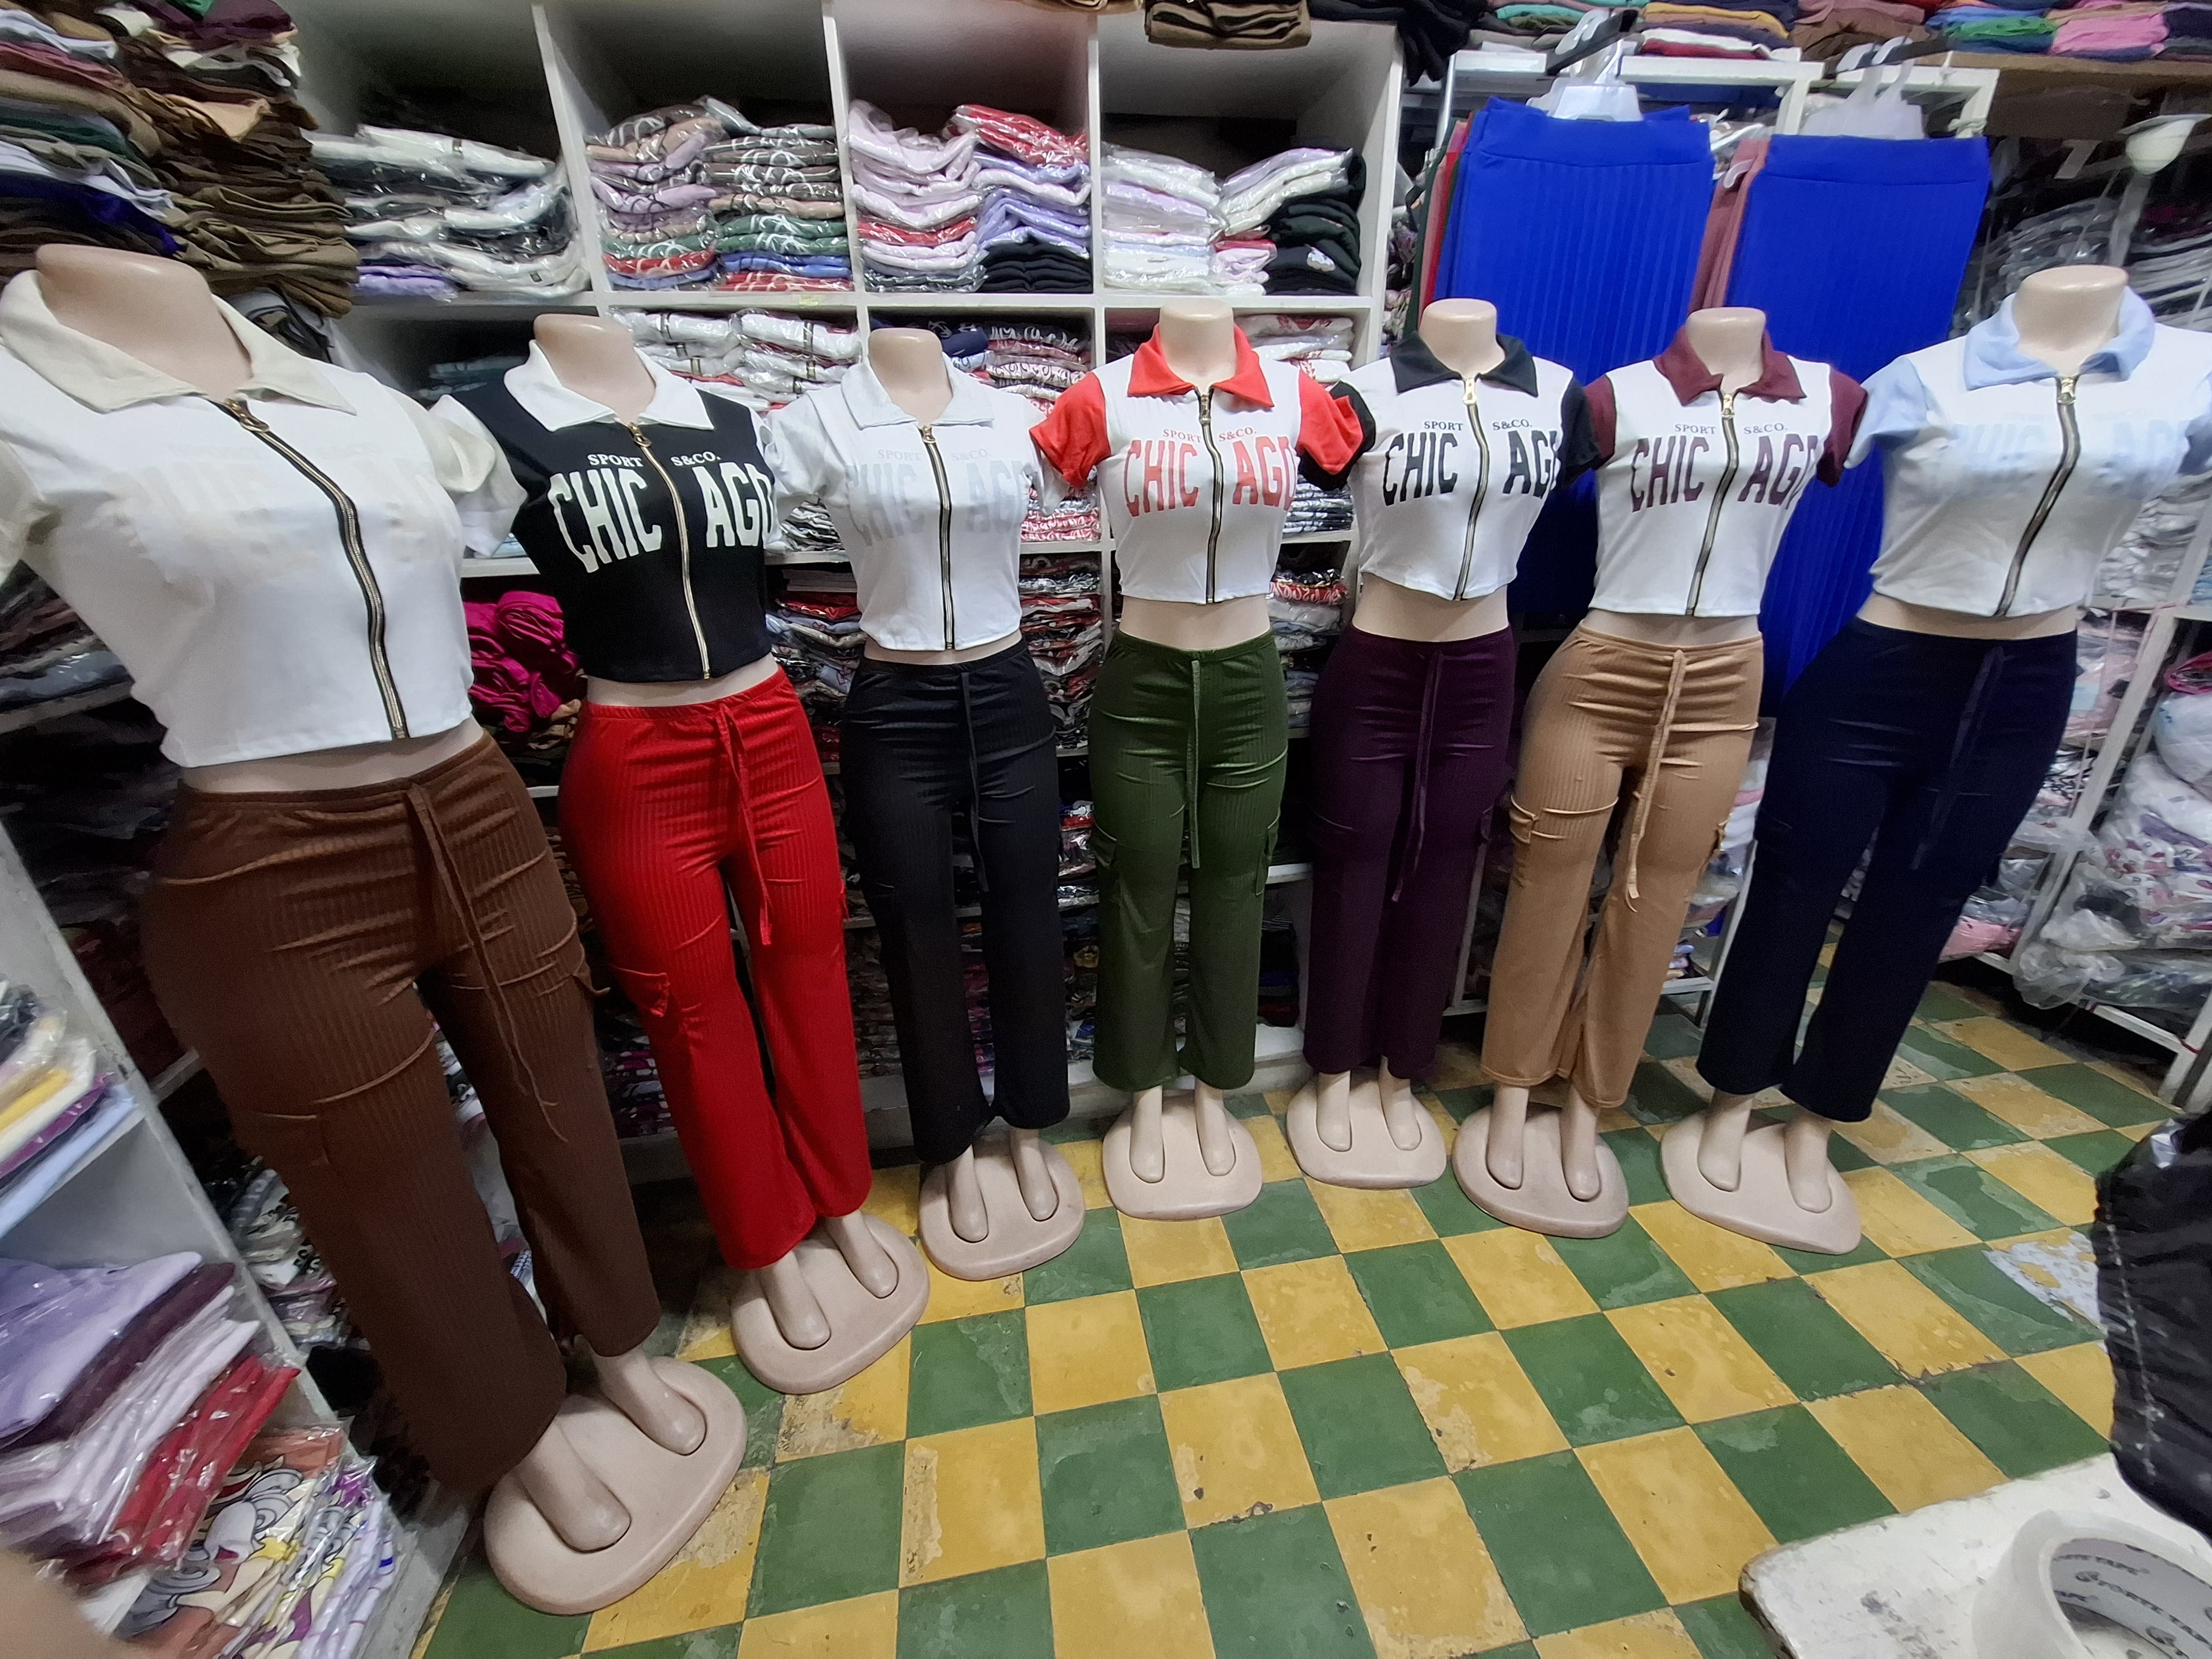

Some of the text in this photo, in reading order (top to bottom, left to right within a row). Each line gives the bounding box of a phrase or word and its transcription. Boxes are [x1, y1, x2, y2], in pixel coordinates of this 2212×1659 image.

[1424, 419, 1533, 431] SPORT S&CO.
[1675, 423, 1789, 434] SPORT S&CO.
[1163, 426, 1257, 443] SPORT S&CO.
[587, 451, 721, 467] SPORT S&CO.
[877, 448, 992, 461] SPORT S&CO.
[1383, 432, 1458, 506] CHIC
[1630, 435, 1709, 513] CHIC
[1123, 440, 1199, 517] CHIC
[547, 467, 663, 574] CHIC
